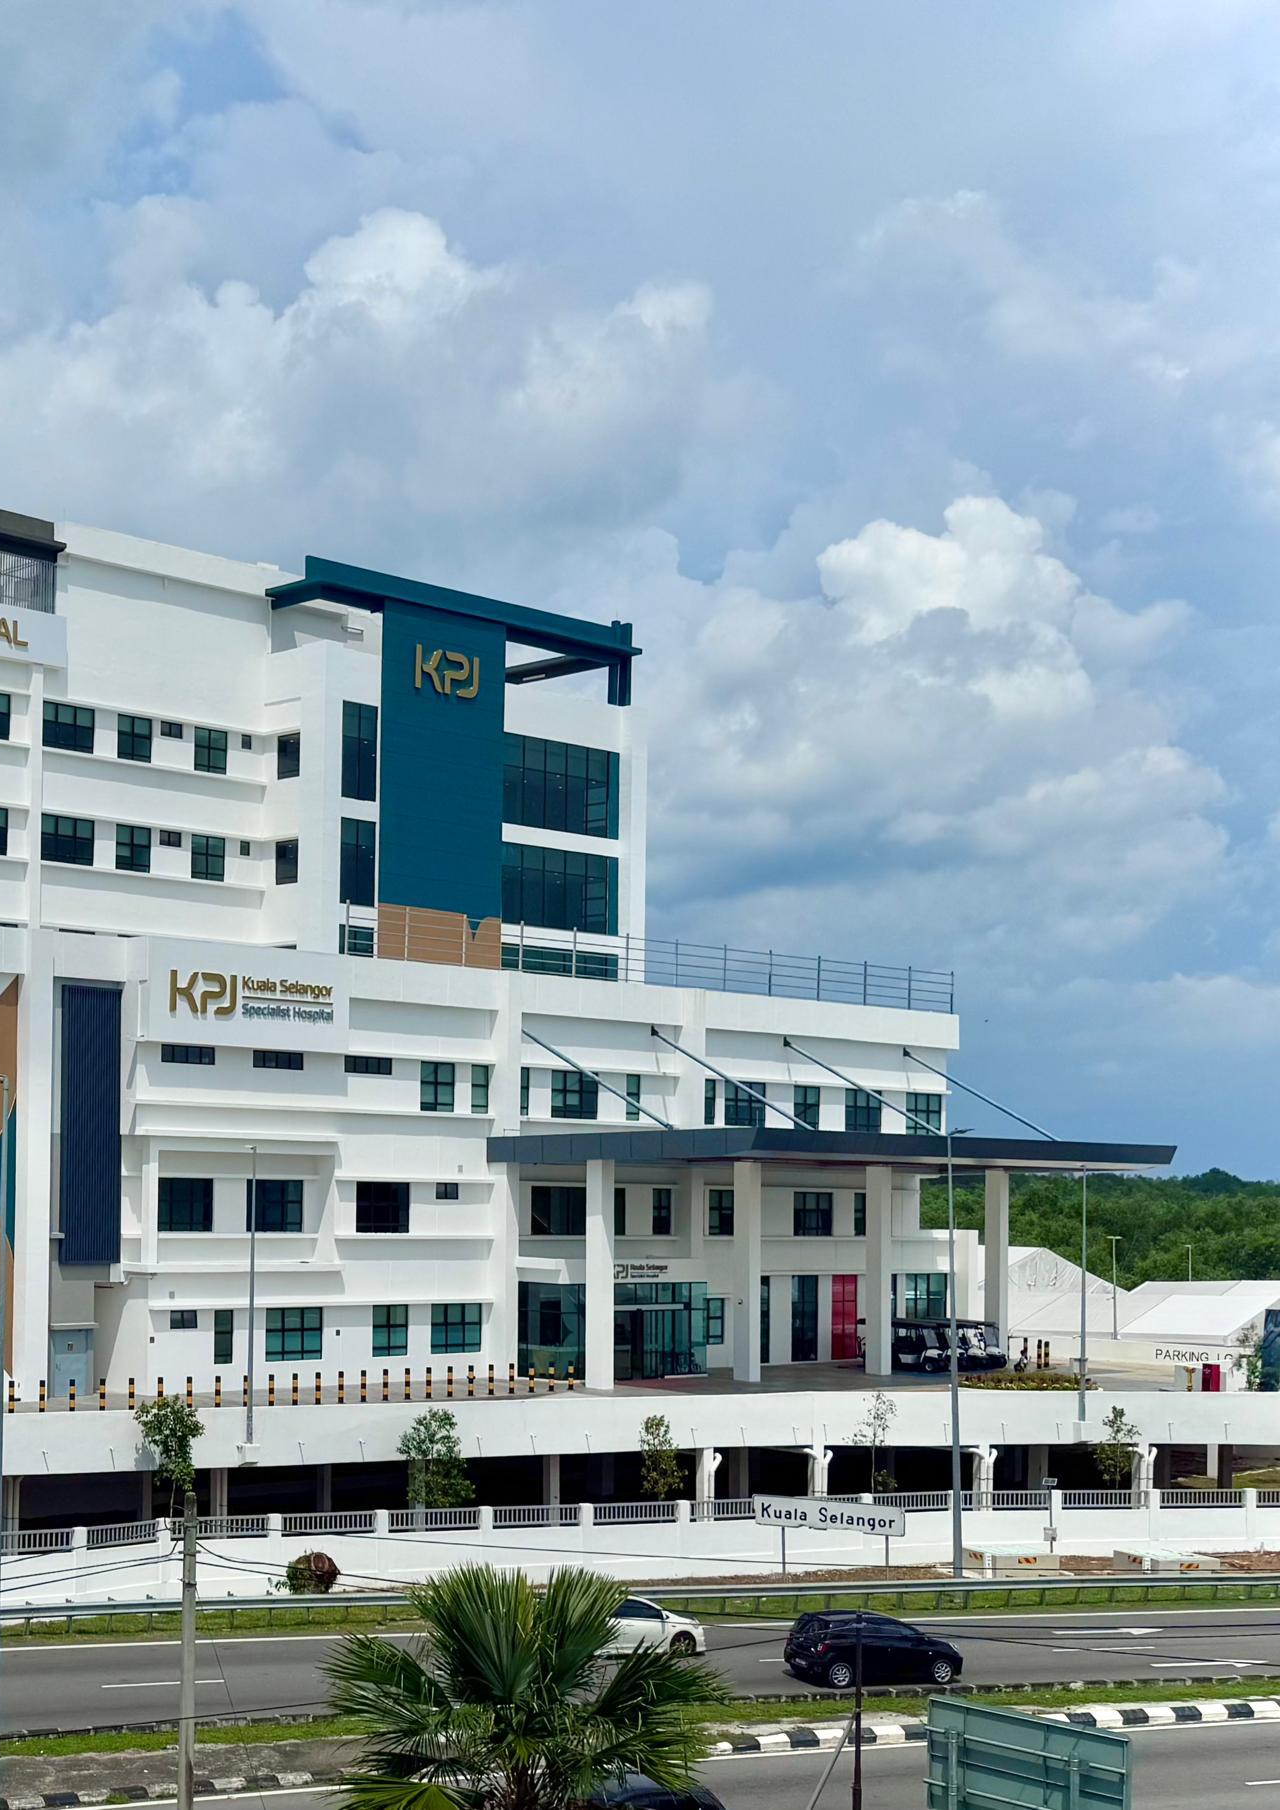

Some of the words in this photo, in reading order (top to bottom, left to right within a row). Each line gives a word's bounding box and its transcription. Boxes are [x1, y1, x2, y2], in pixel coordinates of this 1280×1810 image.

[414, 643, 480, 699] KPJ
[169, 969, 238, 1016] KPJ
[242, 975, 277, 993] Kuala
[279, 979, 334, 999] Selangor
[242, 1003, 291, 1019] Specialist
[293, 1006, 334, 1023] Hospital
[1155, 1348, 1209, 1362] PARKING
[761, 1502, 807, 1521] Kuala
[818, 1507, 895, 1531] Selangor
